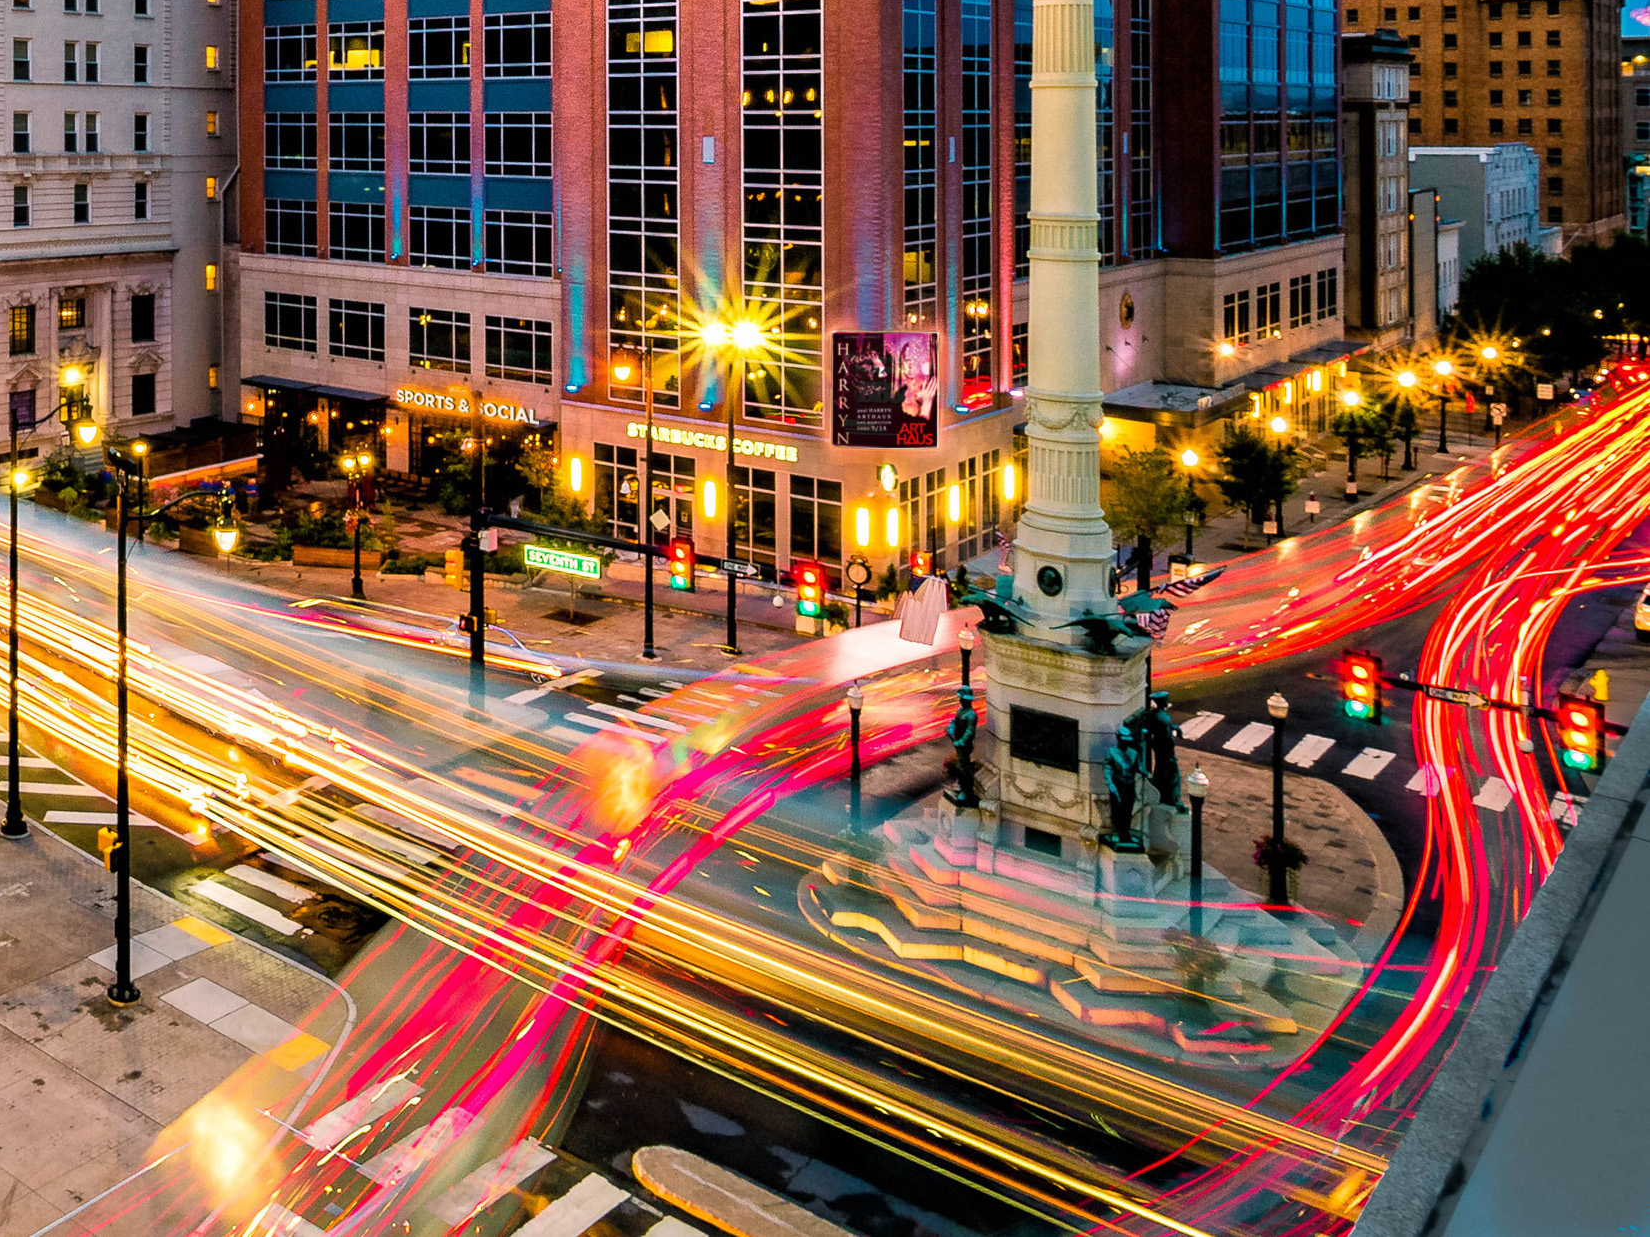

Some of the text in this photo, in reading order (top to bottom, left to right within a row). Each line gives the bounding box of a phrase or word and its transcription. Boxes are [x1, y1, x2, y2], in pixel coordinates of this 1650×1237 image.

[396, 389, 455, 411] SPORTS
[458, 399, 470, 413] &
[837, 343, 850, 445] HARRYN
[896, 433, 934, 445] HAUS
[899, 423, 927, 434] ART
[626, 422, 798, 462] STARBUCKS COFFEE
[528, 550, 595, 572] SEVENTH ST
